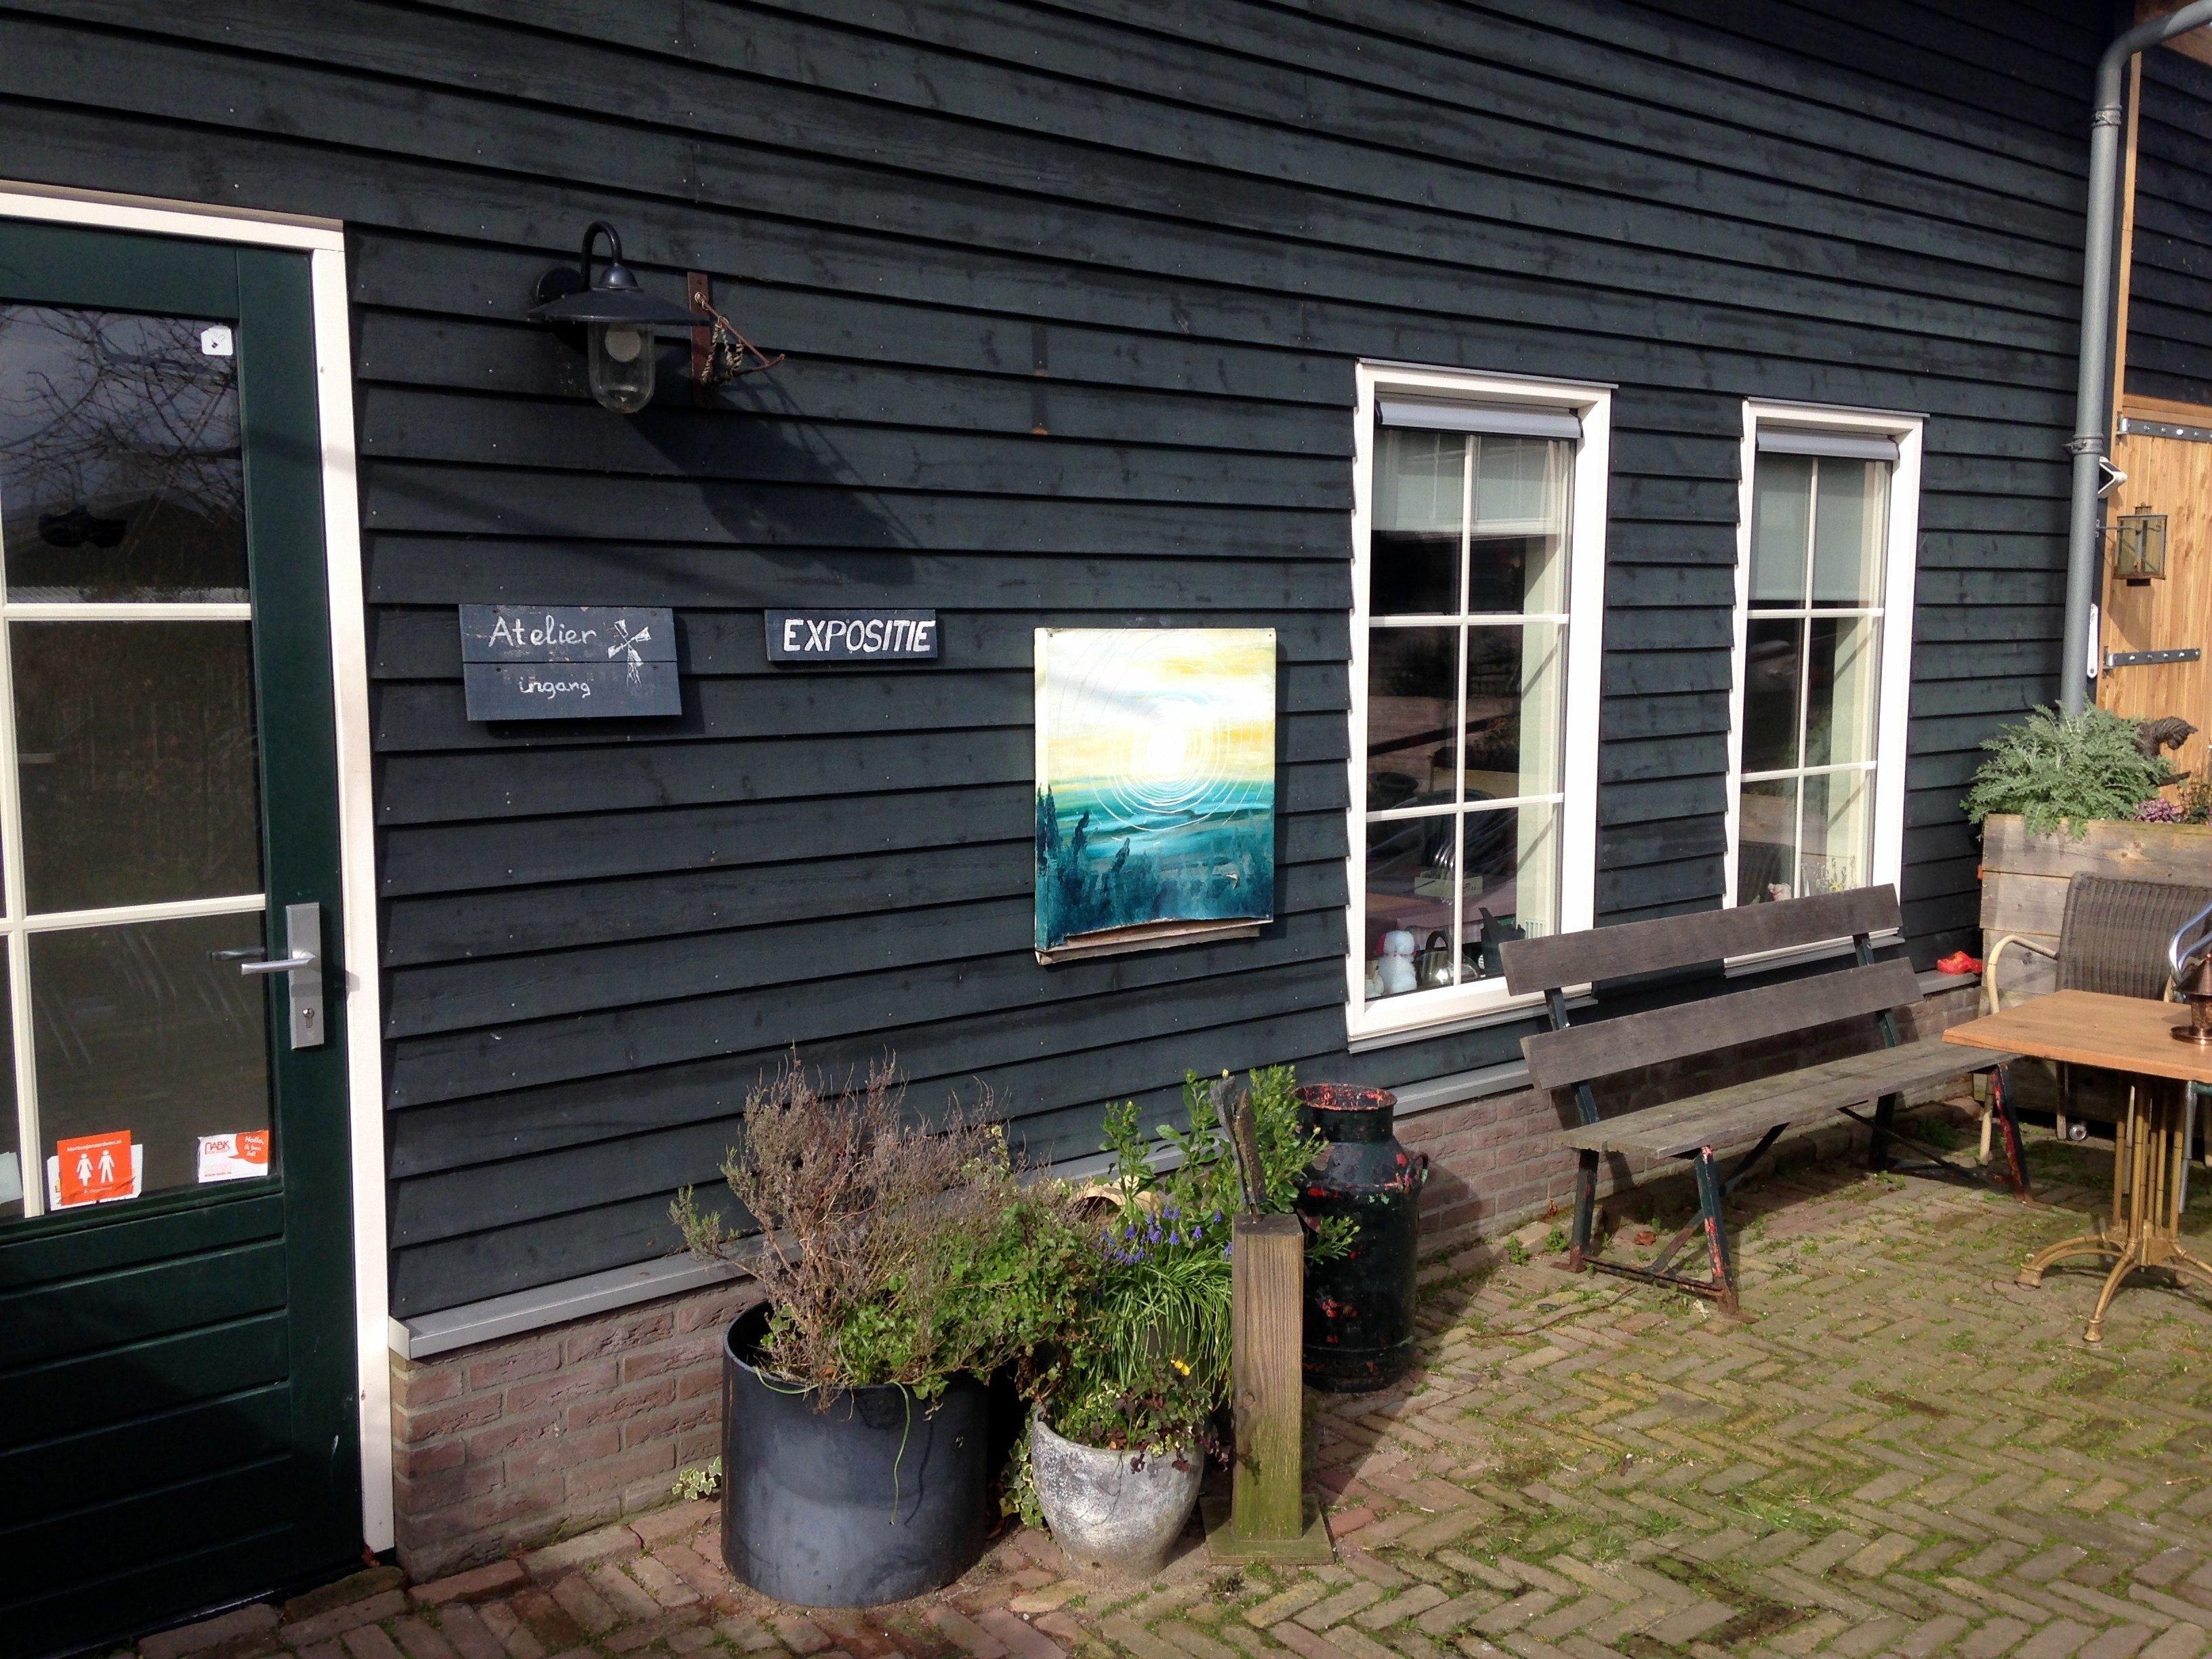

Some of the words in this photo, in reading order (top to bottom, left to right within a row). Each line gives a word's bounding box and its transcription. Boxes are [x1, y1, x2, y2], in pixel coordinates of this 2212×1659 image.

[488, 615, 597, 647] Atelier
[783, 619, 937, 653] EXPOSITIE
[518, 677, 592, 699] ingang
